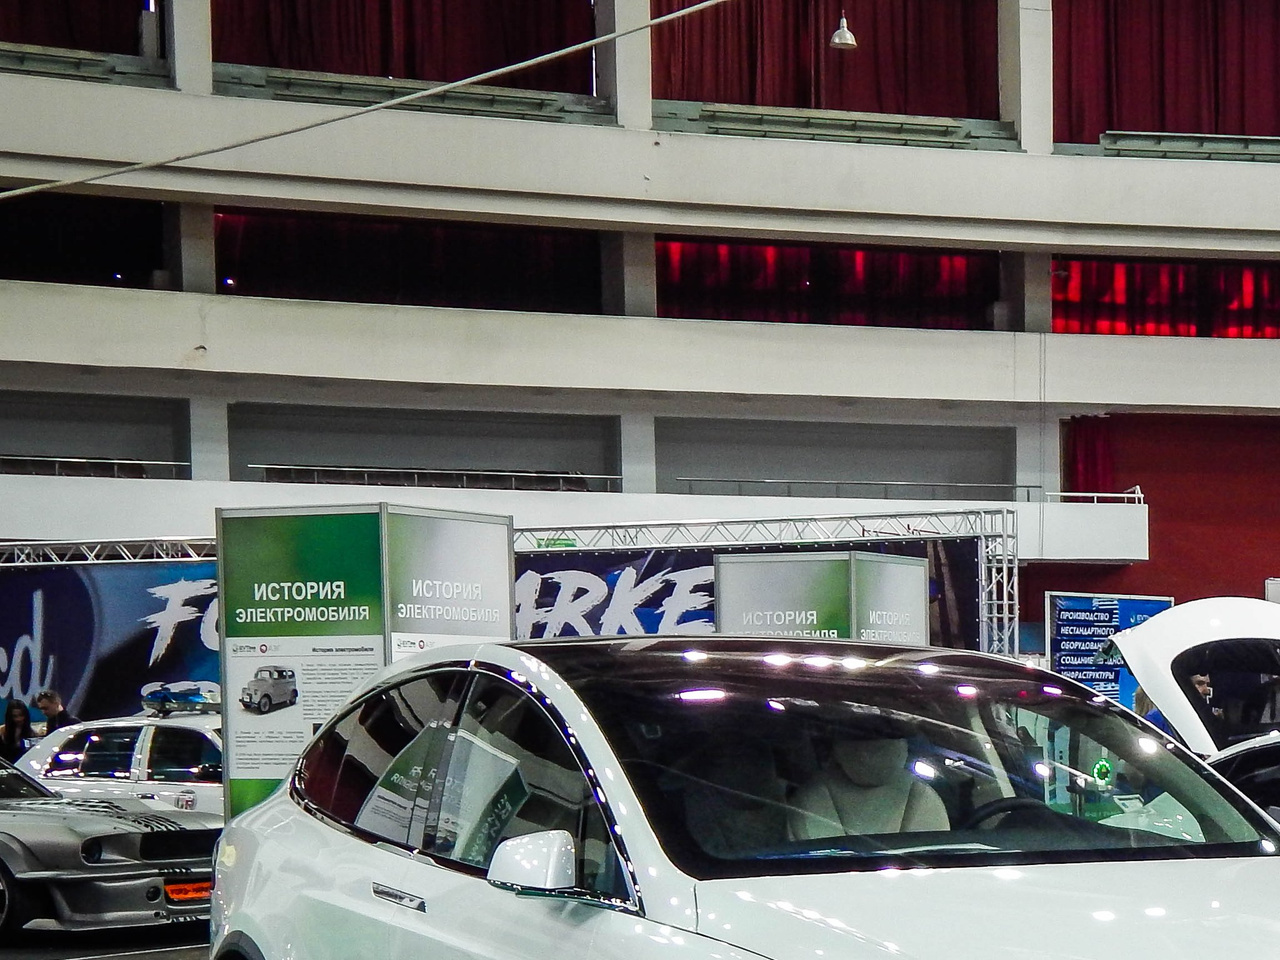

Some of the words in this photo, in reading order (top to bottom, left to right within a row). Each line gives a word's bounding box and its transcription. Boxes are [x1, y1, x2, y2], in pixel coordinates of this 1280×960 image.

[254, 581, 345, 601] ИСТОРИЯ
[412, 579, 482, 600] ИСТОРИЯ
[235, 605, 370, 623] ЭЛЕКТРОМОБИЛЯ
[397, 603, 500, 622] ЭЛЕКТРОМОБИЛЯ
[743, 610, 817, 625] ИСТОРИЯ
[869, 610, 911, 625] ИСТОРИЯ
[1060, 611, 1110, 621] ПРОИЗВОДСТВО
[1060, 626, 1115, 636] НЕСТАНДАРТНОГО
